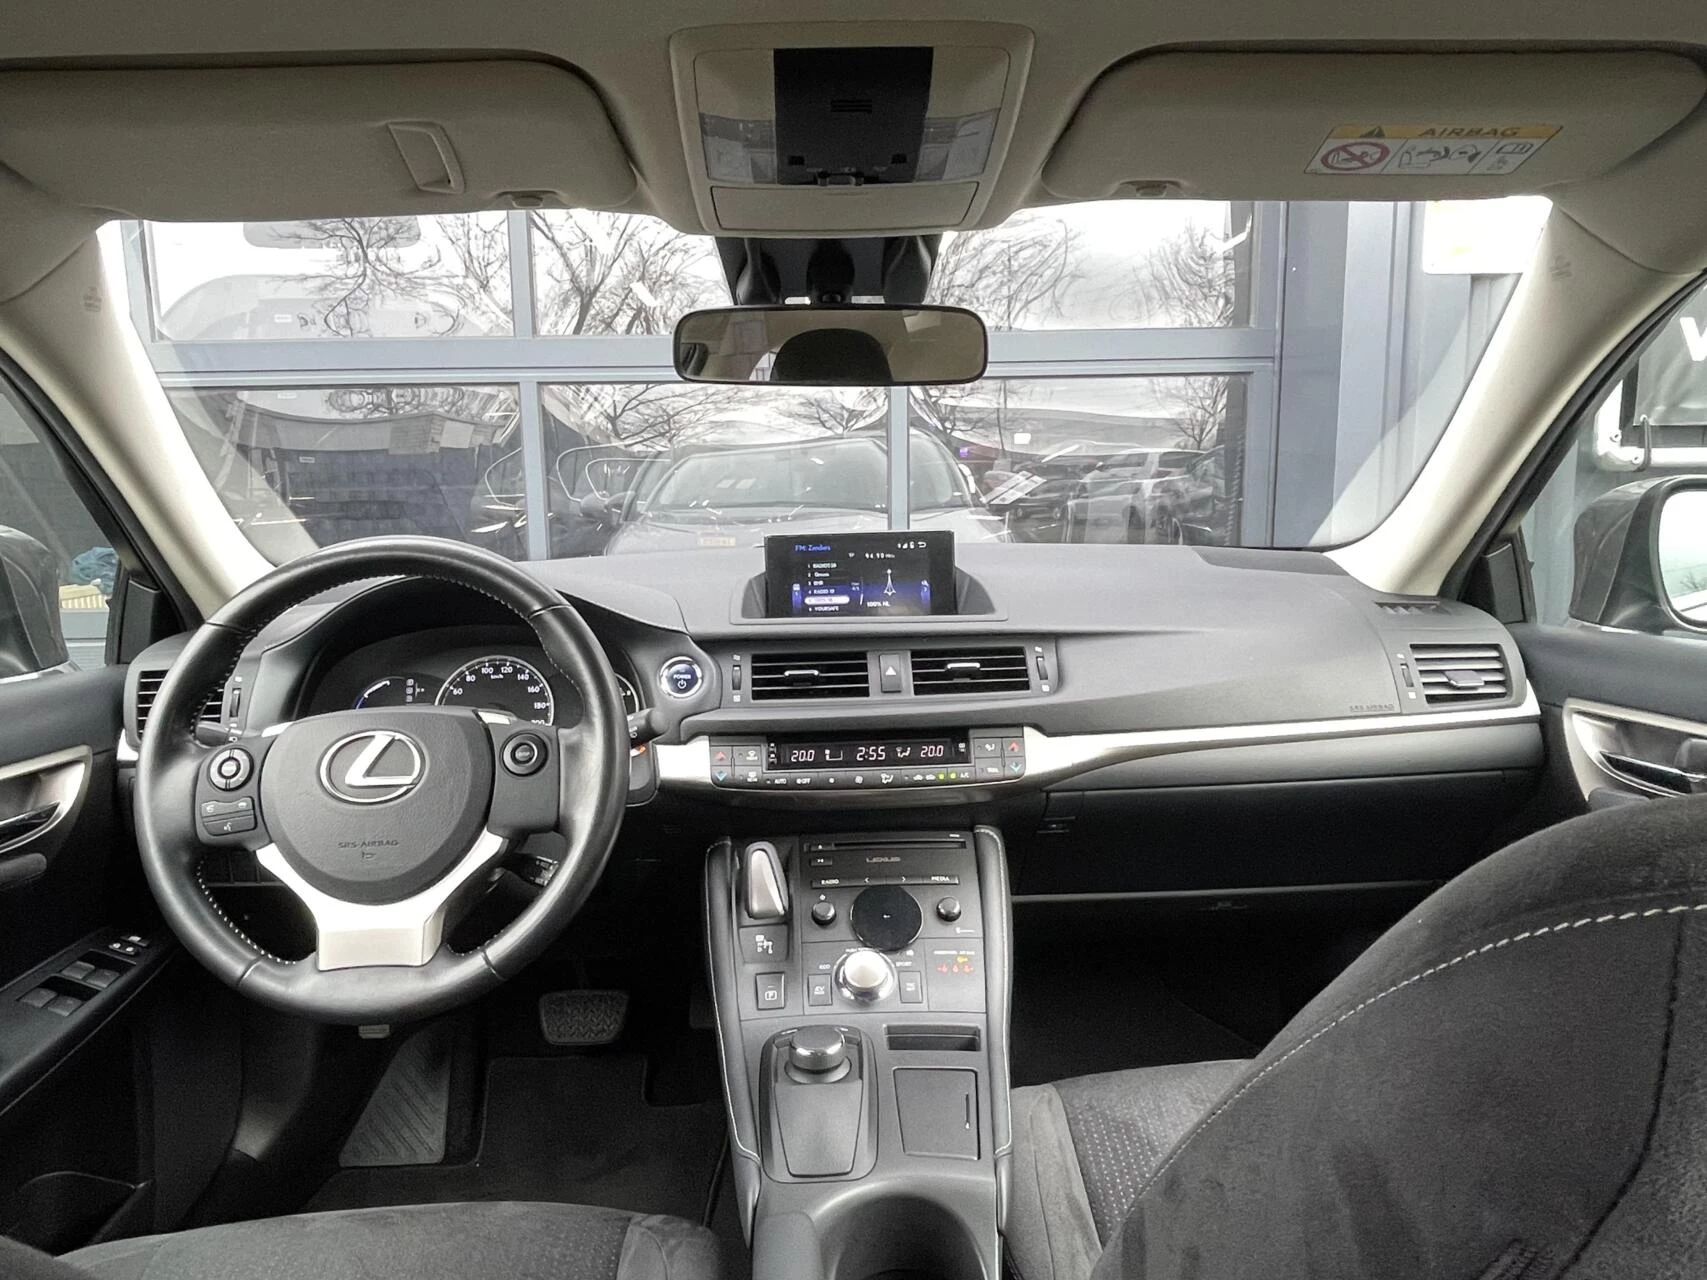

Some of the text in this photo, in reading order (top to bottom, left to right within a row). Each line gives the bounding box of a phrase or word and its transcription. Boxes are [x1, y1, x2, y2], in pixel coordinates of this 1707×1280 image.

[1418, 127, 1521, 138] AIRBAG
[501, 666, 513, 674] 120
[465, 674, 476, 682] 80
[517, 673, 530, 681] 140
[452, 687, 463, 696] 60
[527, 685, 540, 693] 160
[791, 749, 815, 762] 20.0
[856, 745, 886, 761] 2:55
[920, 744, 944, 758] 20.0
